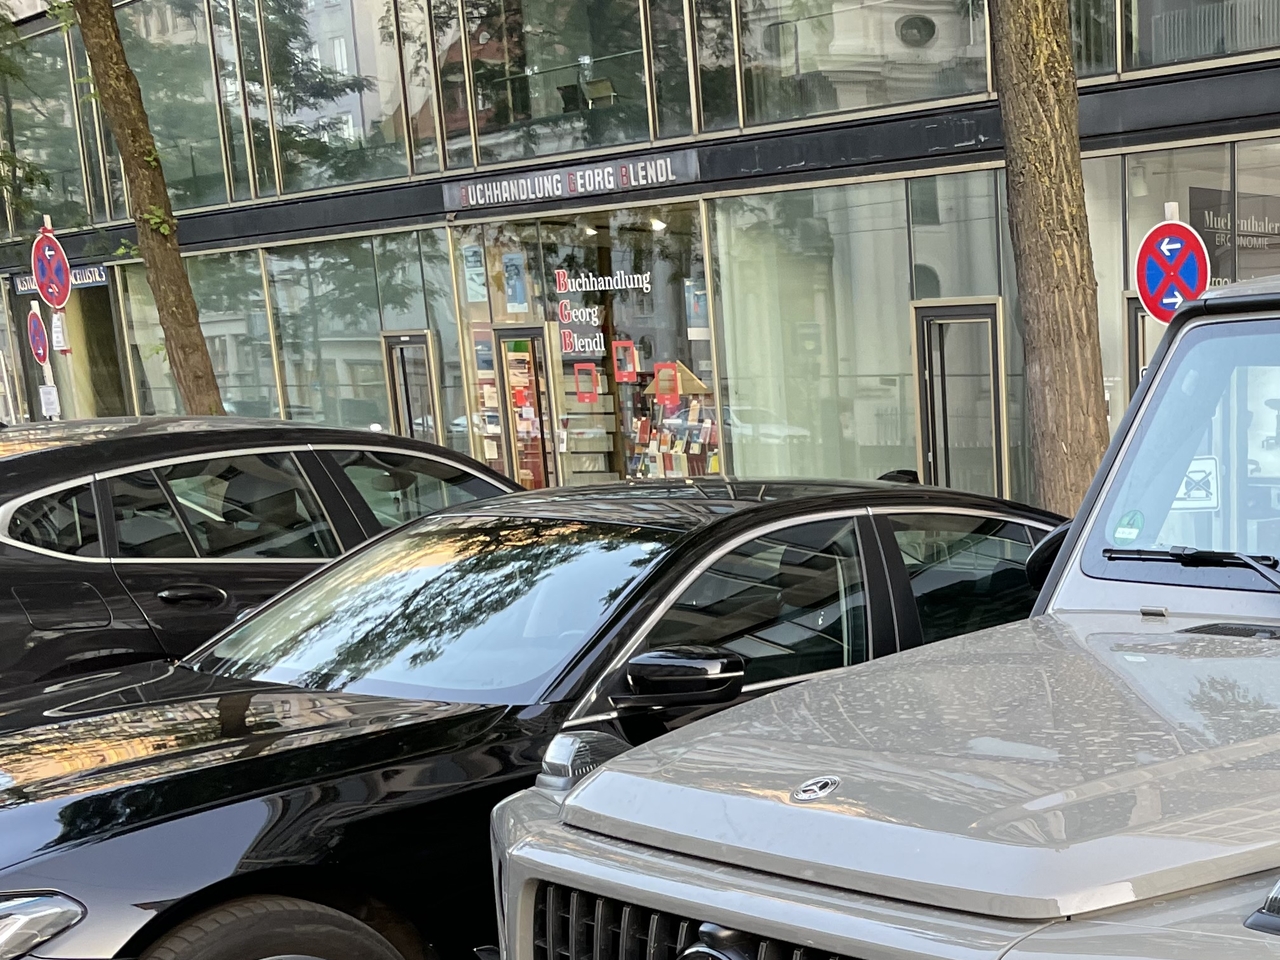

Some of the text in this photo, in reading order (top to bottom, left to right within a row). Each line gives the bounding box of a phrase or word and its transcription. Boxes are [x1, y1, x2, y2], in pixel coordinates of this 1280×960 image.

[460, 157, 676, 207] BUCHHANDLUNG GEORG BLENDL
[1204, 210, 1280, 234] Mucknthaler
[555, 269, 651, 293] Buchhandlung
[559, 300, 599, 326] Georg
[561, 329, 606, 352] Blendl
